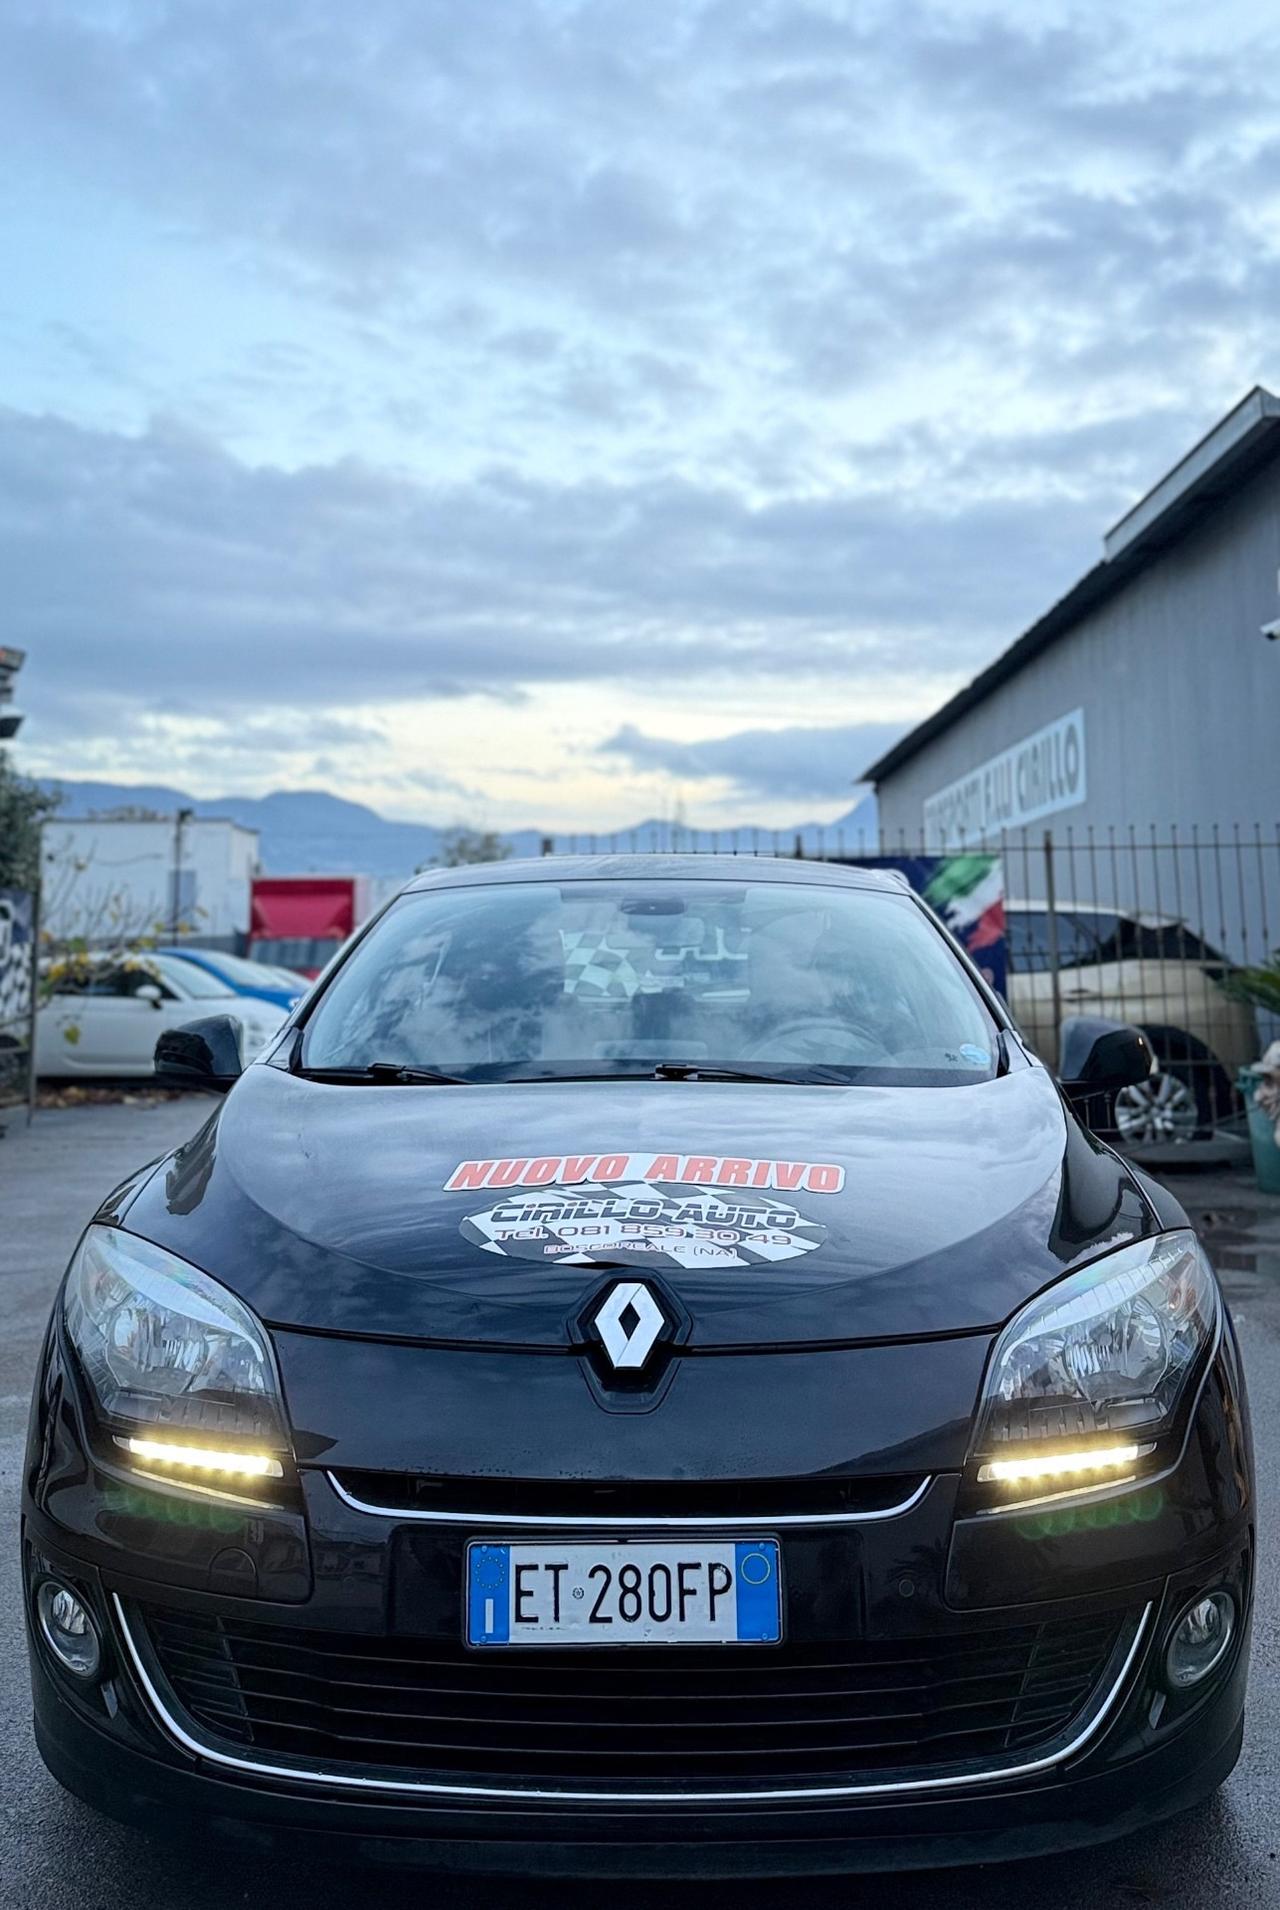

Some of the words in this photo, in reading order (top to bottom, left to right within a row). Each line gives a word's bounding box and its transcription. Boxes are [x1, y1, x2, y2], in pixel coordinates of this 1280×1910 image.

[1018, 723, 1080, 814] CIRILLO
[448, 1155, 631, 1189] NUOVO
[643, 1156, 841, 1192] ARRIVO
[674, 1203, 798, 1228] AUTO
[557, 1225, 611, 1238] 081
[620, 1223, 686, 1239] 859
[694, 1230, 740, 1246] 30
[746, 1232, 792, 1246] 49
[544, 1242, 686, 1255] BOSCOREALE
[693, 1246, 738, 1260] (NA)
[514, 1563, 569, 1623] ET
[588, 1562, 733, 1624] 280FP
